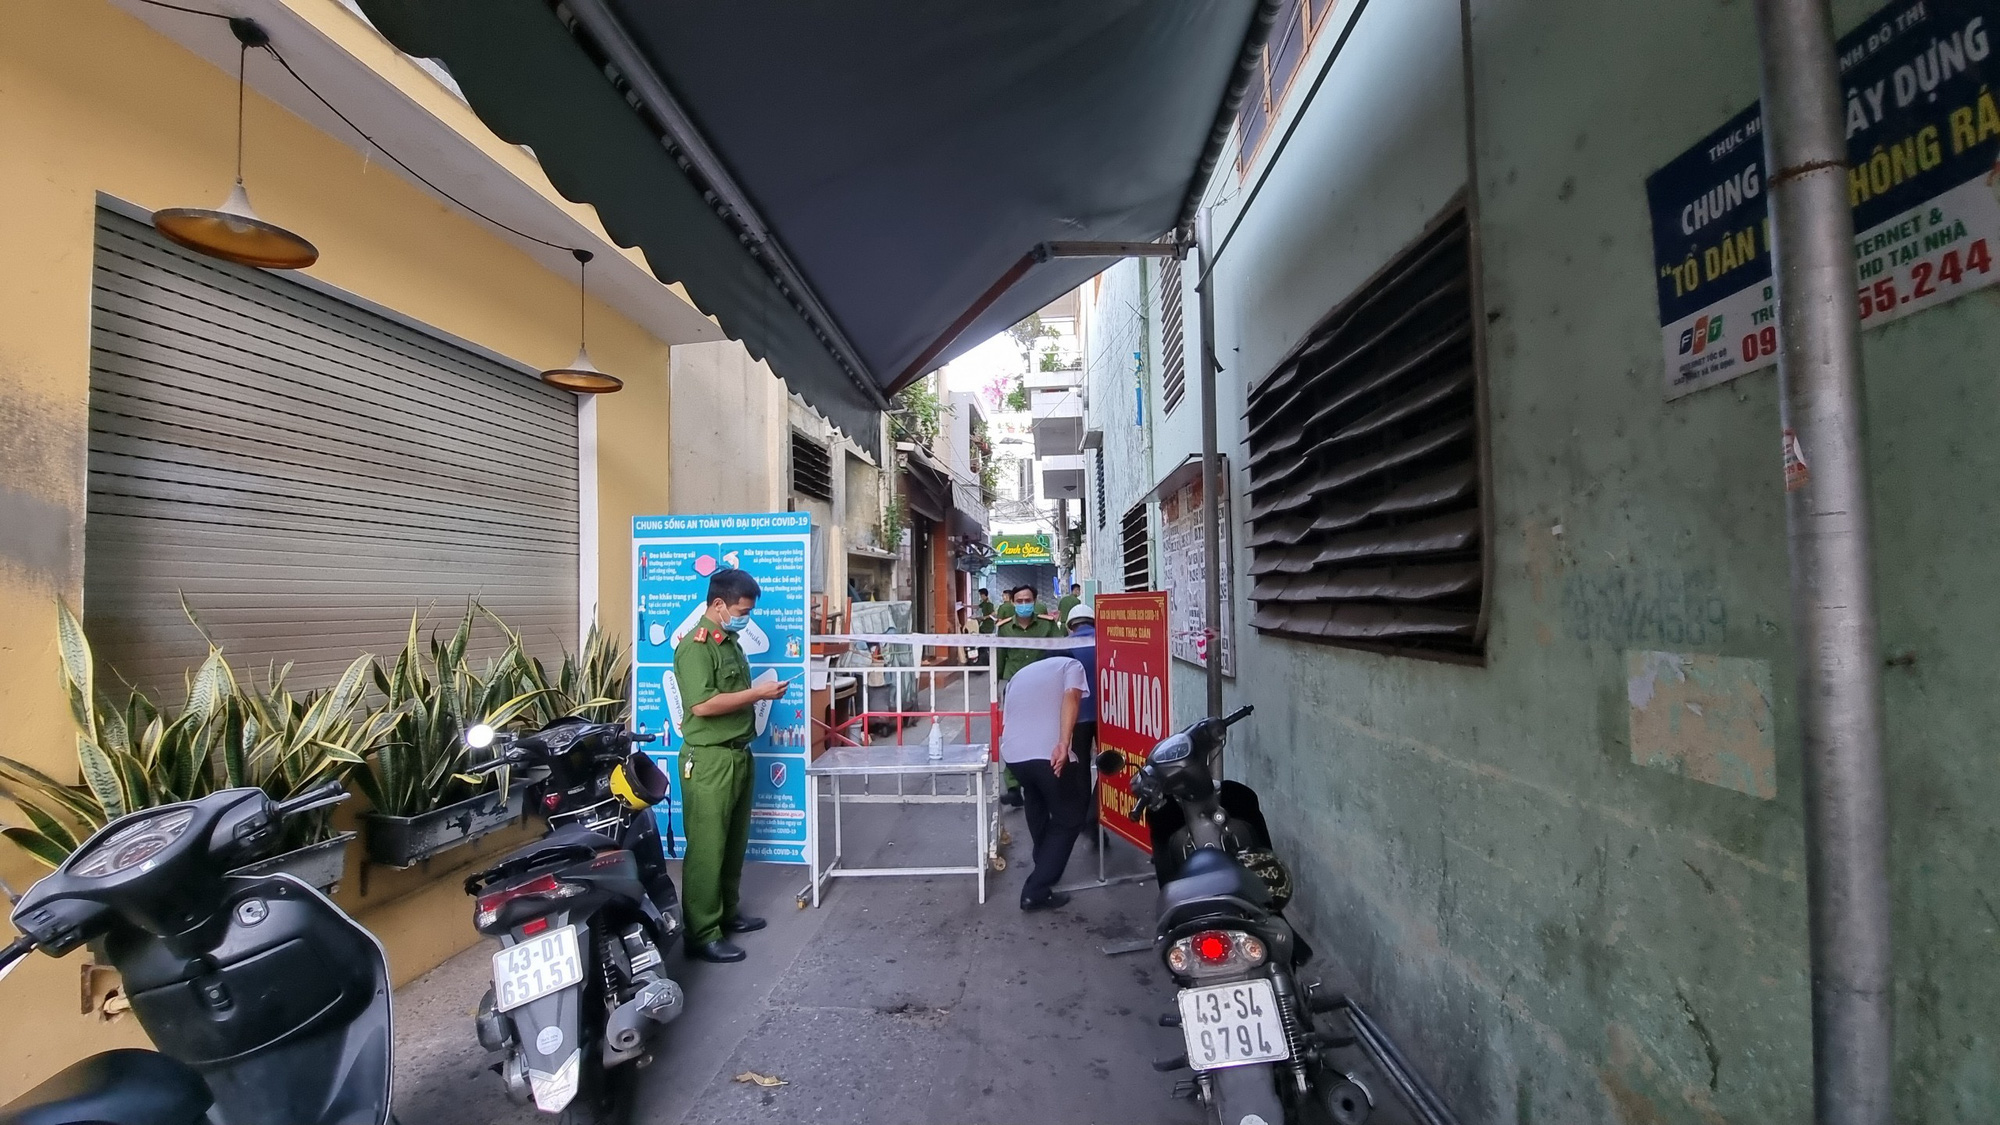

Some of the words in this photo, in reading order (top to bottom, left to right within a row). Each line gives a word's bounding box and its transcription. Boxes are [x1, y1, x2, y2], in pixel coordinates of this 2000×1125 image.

[1867, 22, 1893, 52] ĐÔ
[1681, 162, 1760, 236] CHUNG
[1893, 15, 1990, 108] DỰNG
[1708, 128, 1743, 162] THỰC
[1929, 206, 1943, 226] &
[1704, 225, 1756, 282] DÂN
[1859, 256, 1884, 281] HD
[1888, 240, 1919, 267] TẠI
[1923, 218, 1968, 253] NHÀ
[1680, 317, 1723, 353] FPT
[1742, 326, 1777, 362] 09
[636, 520, 663, 530] CHUNG
[664, 518, 686, 530] SỐNG
[686, 520, 698, 529] AN
[699, 518, 720, 529] TOÀN
[721, 516, 734, 528] VỚI
[736, 518, 750, 530] ĐẠI
[751, 518, 770, 530] DỊCH
[772, 516, 808, 526] COVID-19
[1022, 542, 1044, 558] Spa
[1107, 624, 1125, 637] PHƯỜNG
[1126, 627, 1138, 640] THẠC
[1100, 650, 1129, 730] CẤM
[1132, 662, 1162, 740] VÀO
[1102, 779, 1118, 812] VÙNG
[761, 848, 773, 856] dịch
[507, 933, 565, 974] 43-D1
[502, 956, 576, 1006] 651.51
[1195, 987, 1263, 1026] 43-S4
[1200, 1022, 1272, 1062] 9794
